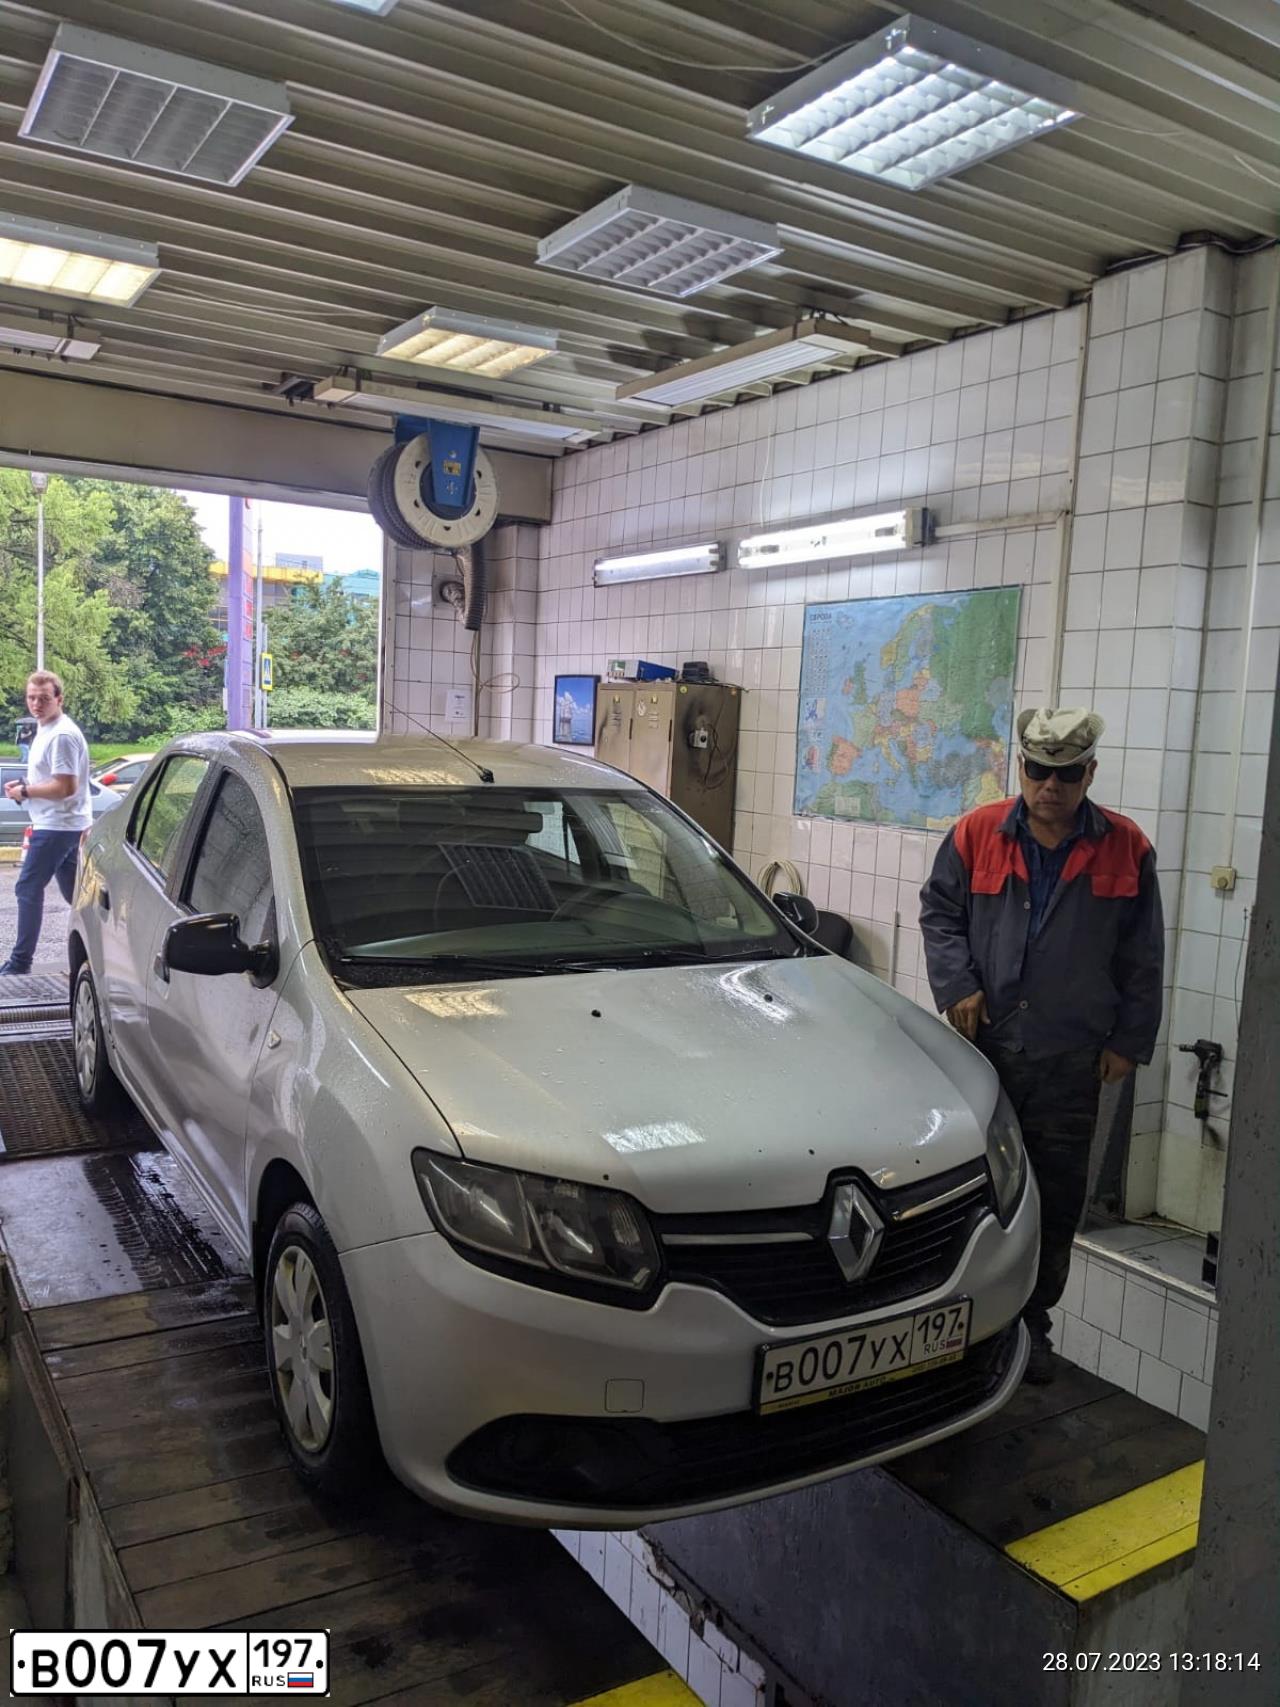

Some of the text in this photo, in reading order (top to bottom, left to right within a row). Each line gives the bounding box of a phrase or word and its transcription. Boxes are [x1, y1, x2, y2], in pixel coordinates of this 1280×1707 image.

[917, 1307, 961, 1344] 197
[773, 1331, 909, 1393] В007УХ
[924, 1342, 945, 1355] RUS
